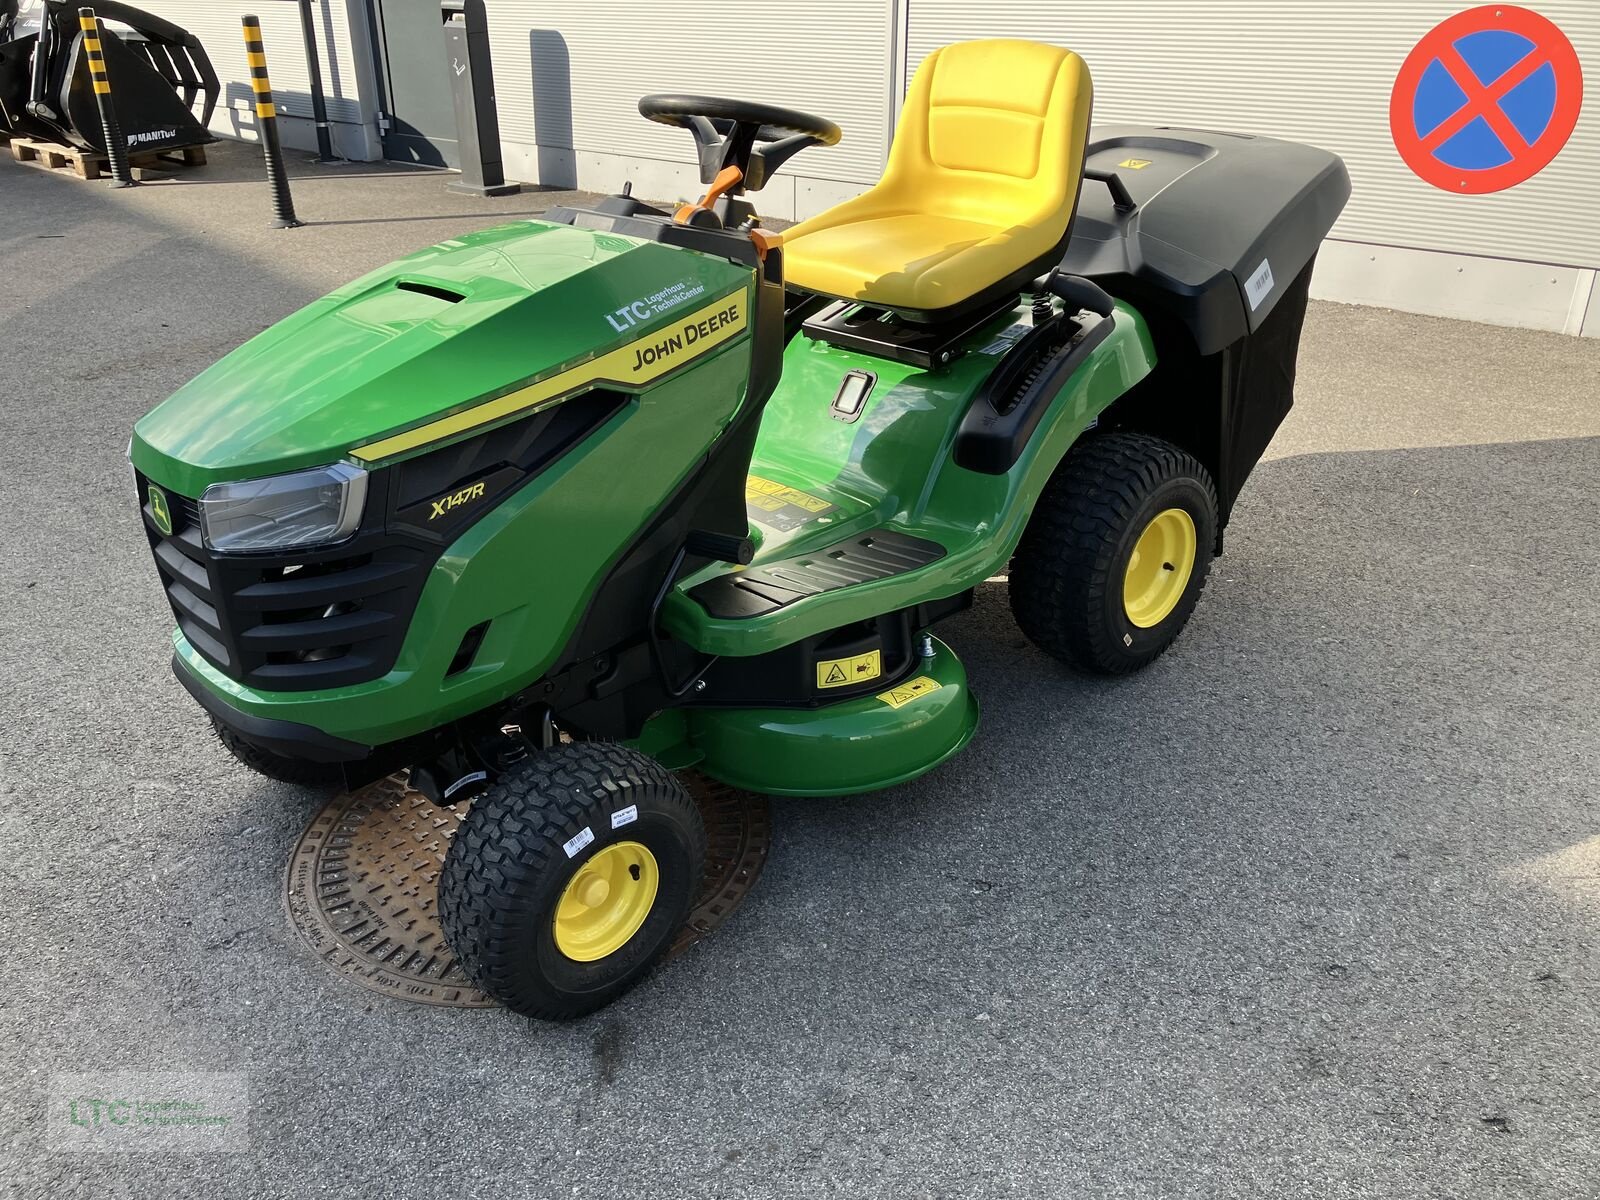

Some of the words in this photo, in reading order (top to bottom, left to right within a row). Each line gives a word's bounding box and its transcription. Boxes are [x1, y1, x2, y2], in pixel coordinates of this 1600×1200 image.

[138, 129, 176, 142] MANITOU
[644, 282, 685, 304] Lagerhaus
[651, 285, 705, 313] TechnikCenter
[606, 301, 651, 333] LTC
[633, 334, 682, 371] JOHN
[684, 305, 739, 345] DEERE
[429, 482, 485, 520] X147R
